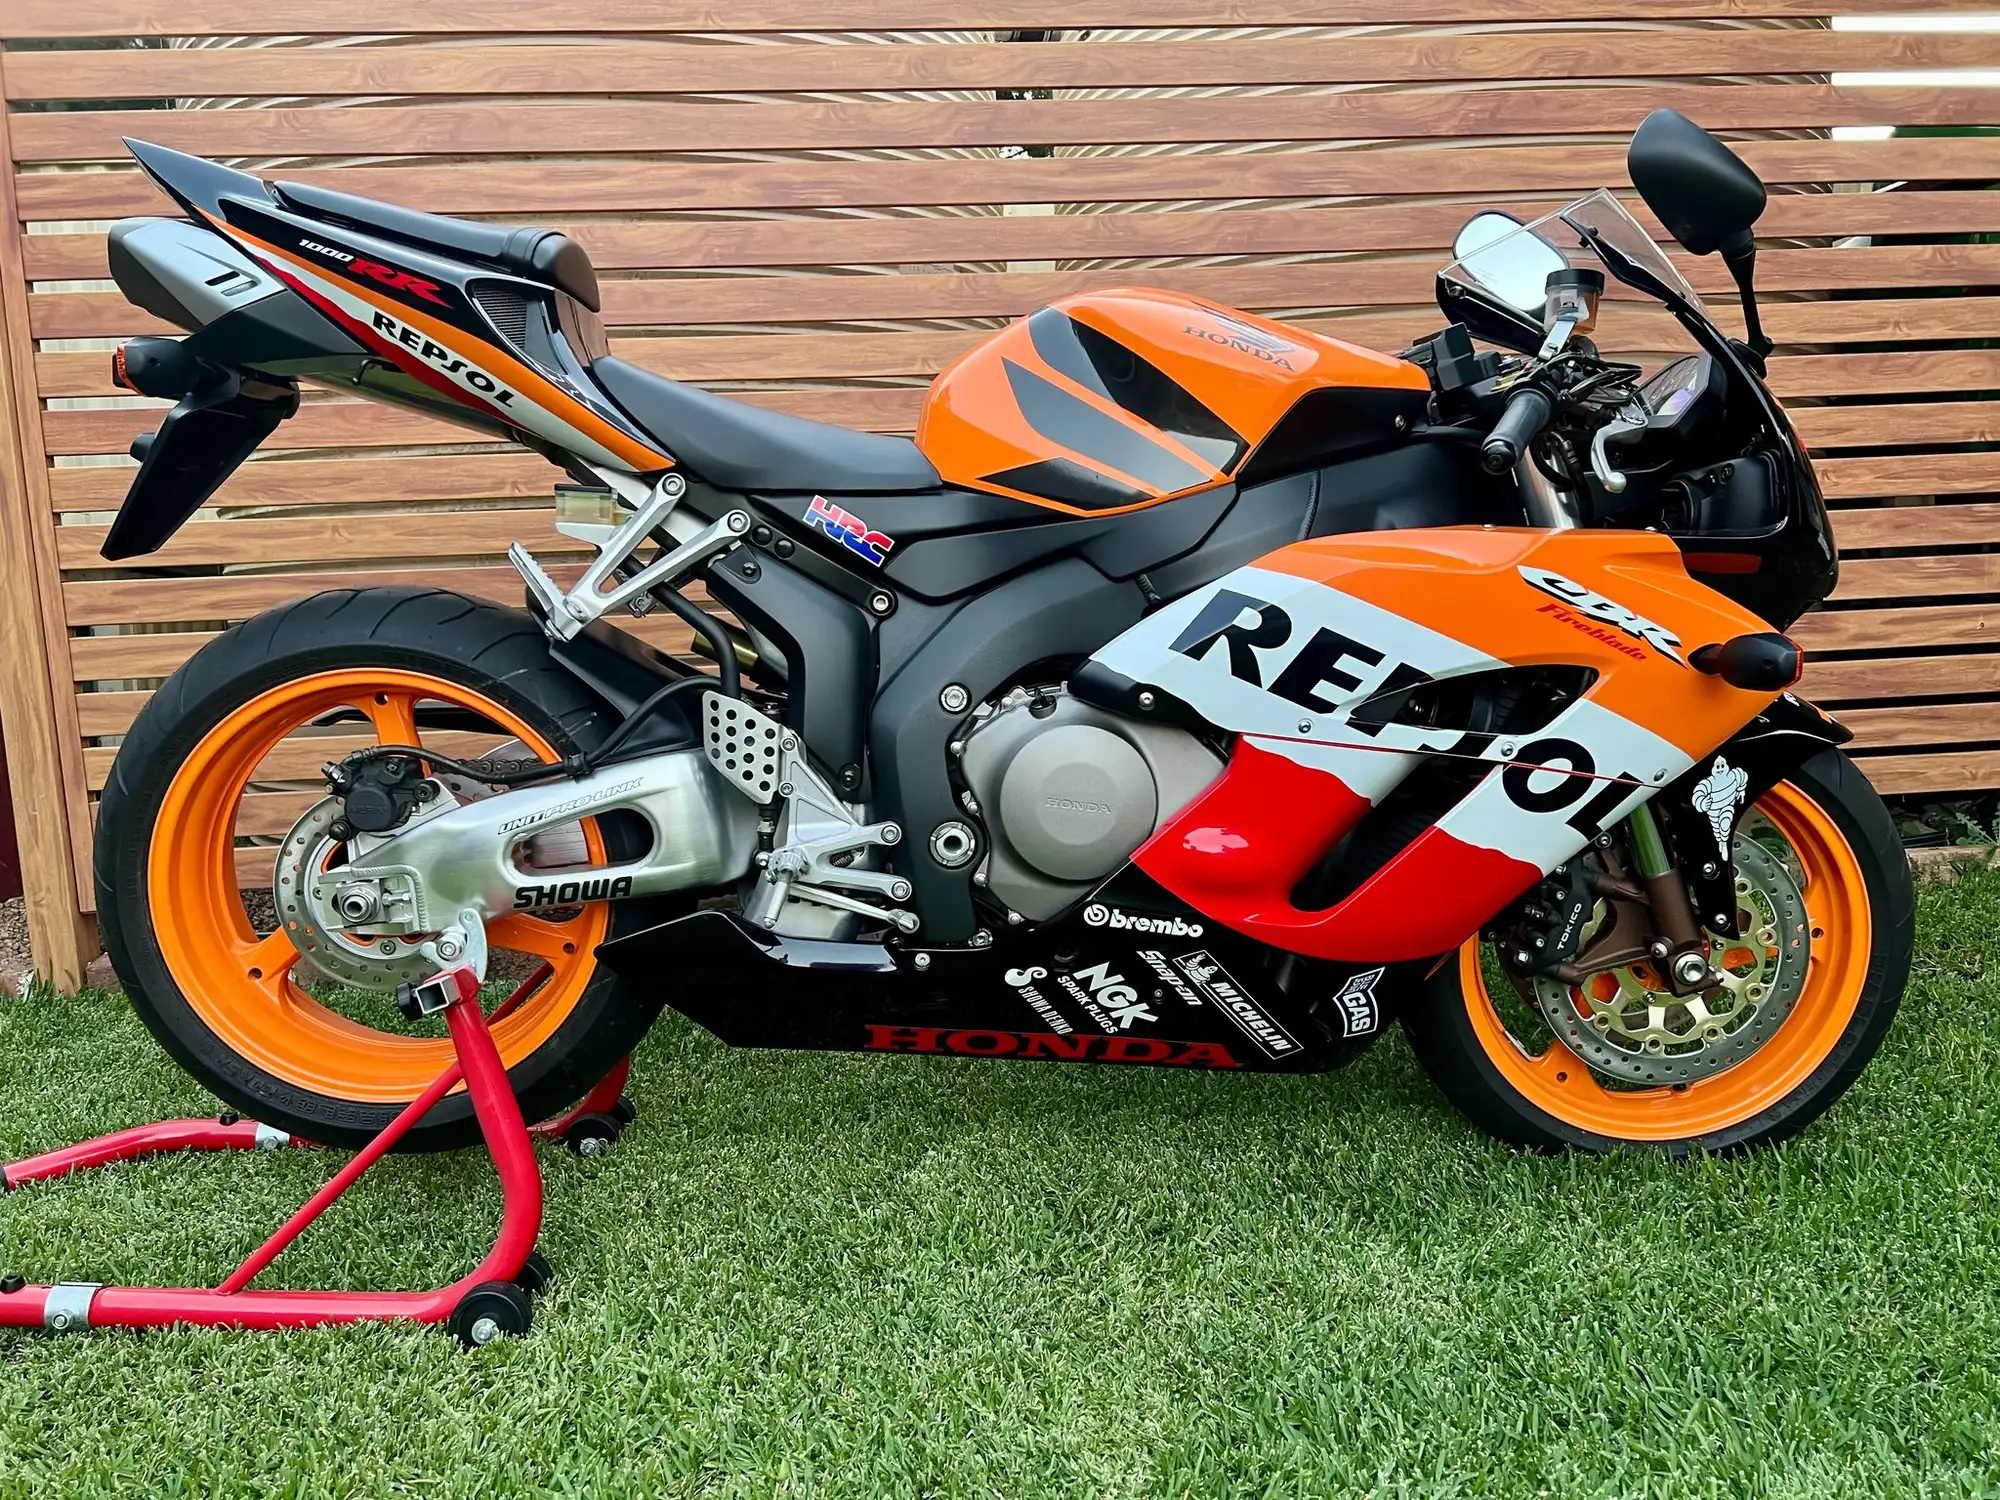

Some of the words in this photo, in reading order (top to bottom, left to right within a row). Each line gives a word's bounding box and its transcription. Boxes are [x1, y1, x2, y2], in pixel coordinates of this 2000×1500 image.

[299, 239, 355, 263] 1000
[372, 311, 516, 408] REPSOL
[1183, 326, 1295, 373] HONDA
[802, 495, 895, 568] HRC
[1516, 564, 1688, 670] CBR
[1535, 603, 1647, 661] Fireblade
[498, 810, 545, 835] UNIT
[1045, 796, 1112, 815] HONDA
[513, 876, 633, 909] SHOWA
[1109, 908, 1204, 938] brembo
[1557, 903, 1582, 950] TOKICO
[1018, 986, 1052, 1013] SHOWA
[1041, 1010, 1073, 1035] DENKO
[1057, 975, 1092, 1006] SPARK
[1084, 1004, 1118, 1034] PLUGS
[1072, 961, 1159, 1029] NGK
[1210, 981, 1292, 1051] MICHELIN
[1342, 991, 1371, 1032] GAS
[864, 1024, 1244, 1068] HONDA
